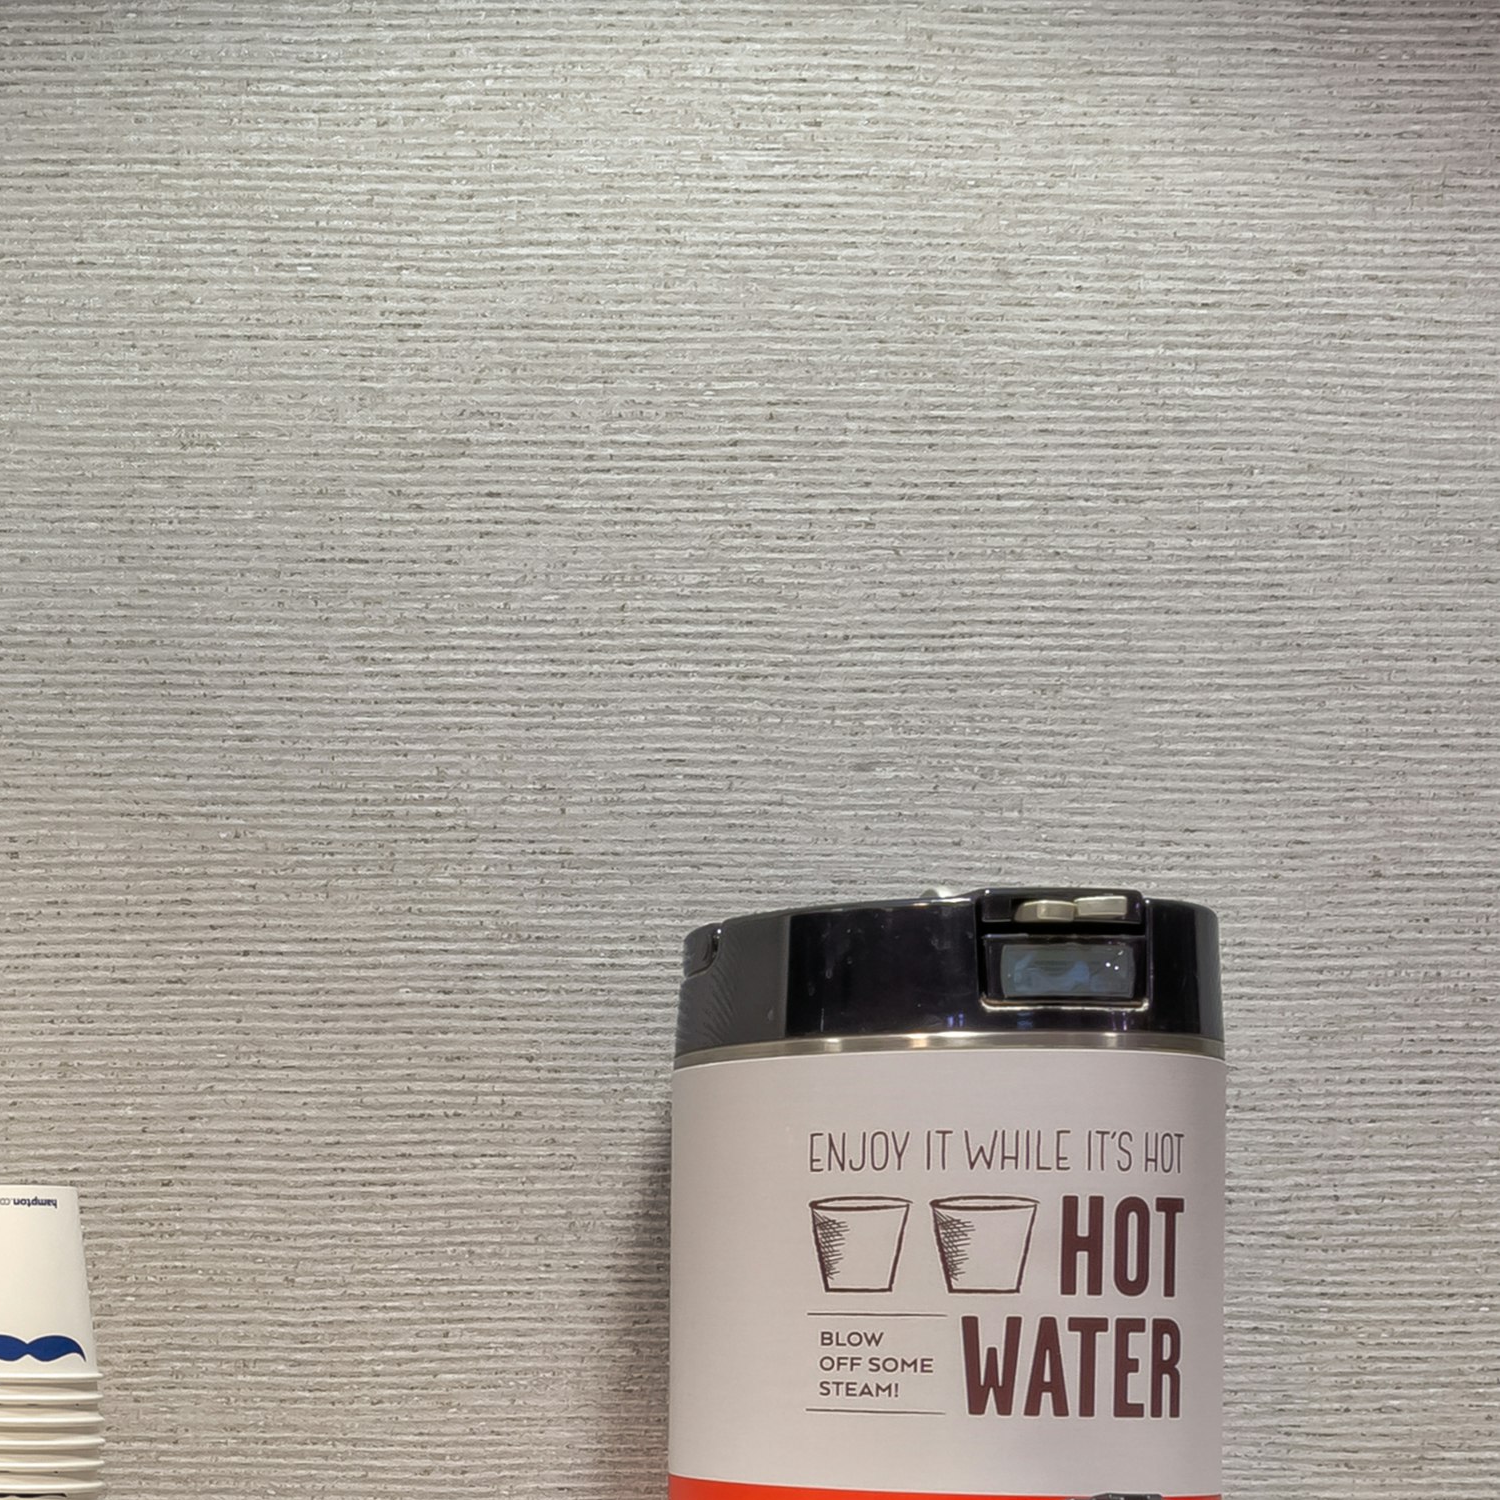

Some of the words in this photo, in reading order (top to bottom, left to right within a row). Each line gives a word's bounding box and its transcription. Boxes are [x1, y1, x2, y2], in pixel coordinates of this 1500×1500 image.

[808, 1130, 911, 1173] ENJOY
[924, 1129, 954, 1171] IT
[963, 1129, 1072, 1171] WHILE
[1086, 1130, 1134, 1172] IT'S
[1143, 1131, 1185, 1174] HOT
[1059, 1194, 1186, 1298] HOT
[819, 1330, 884, 1348] BLOW
[818, 1356, 863, 1373] OFF
[867, 1356, 934, 1374] SOME
[960, 1315, 1182, 1419] WATER
[818, 1381, 900, 1399] STEAM!
